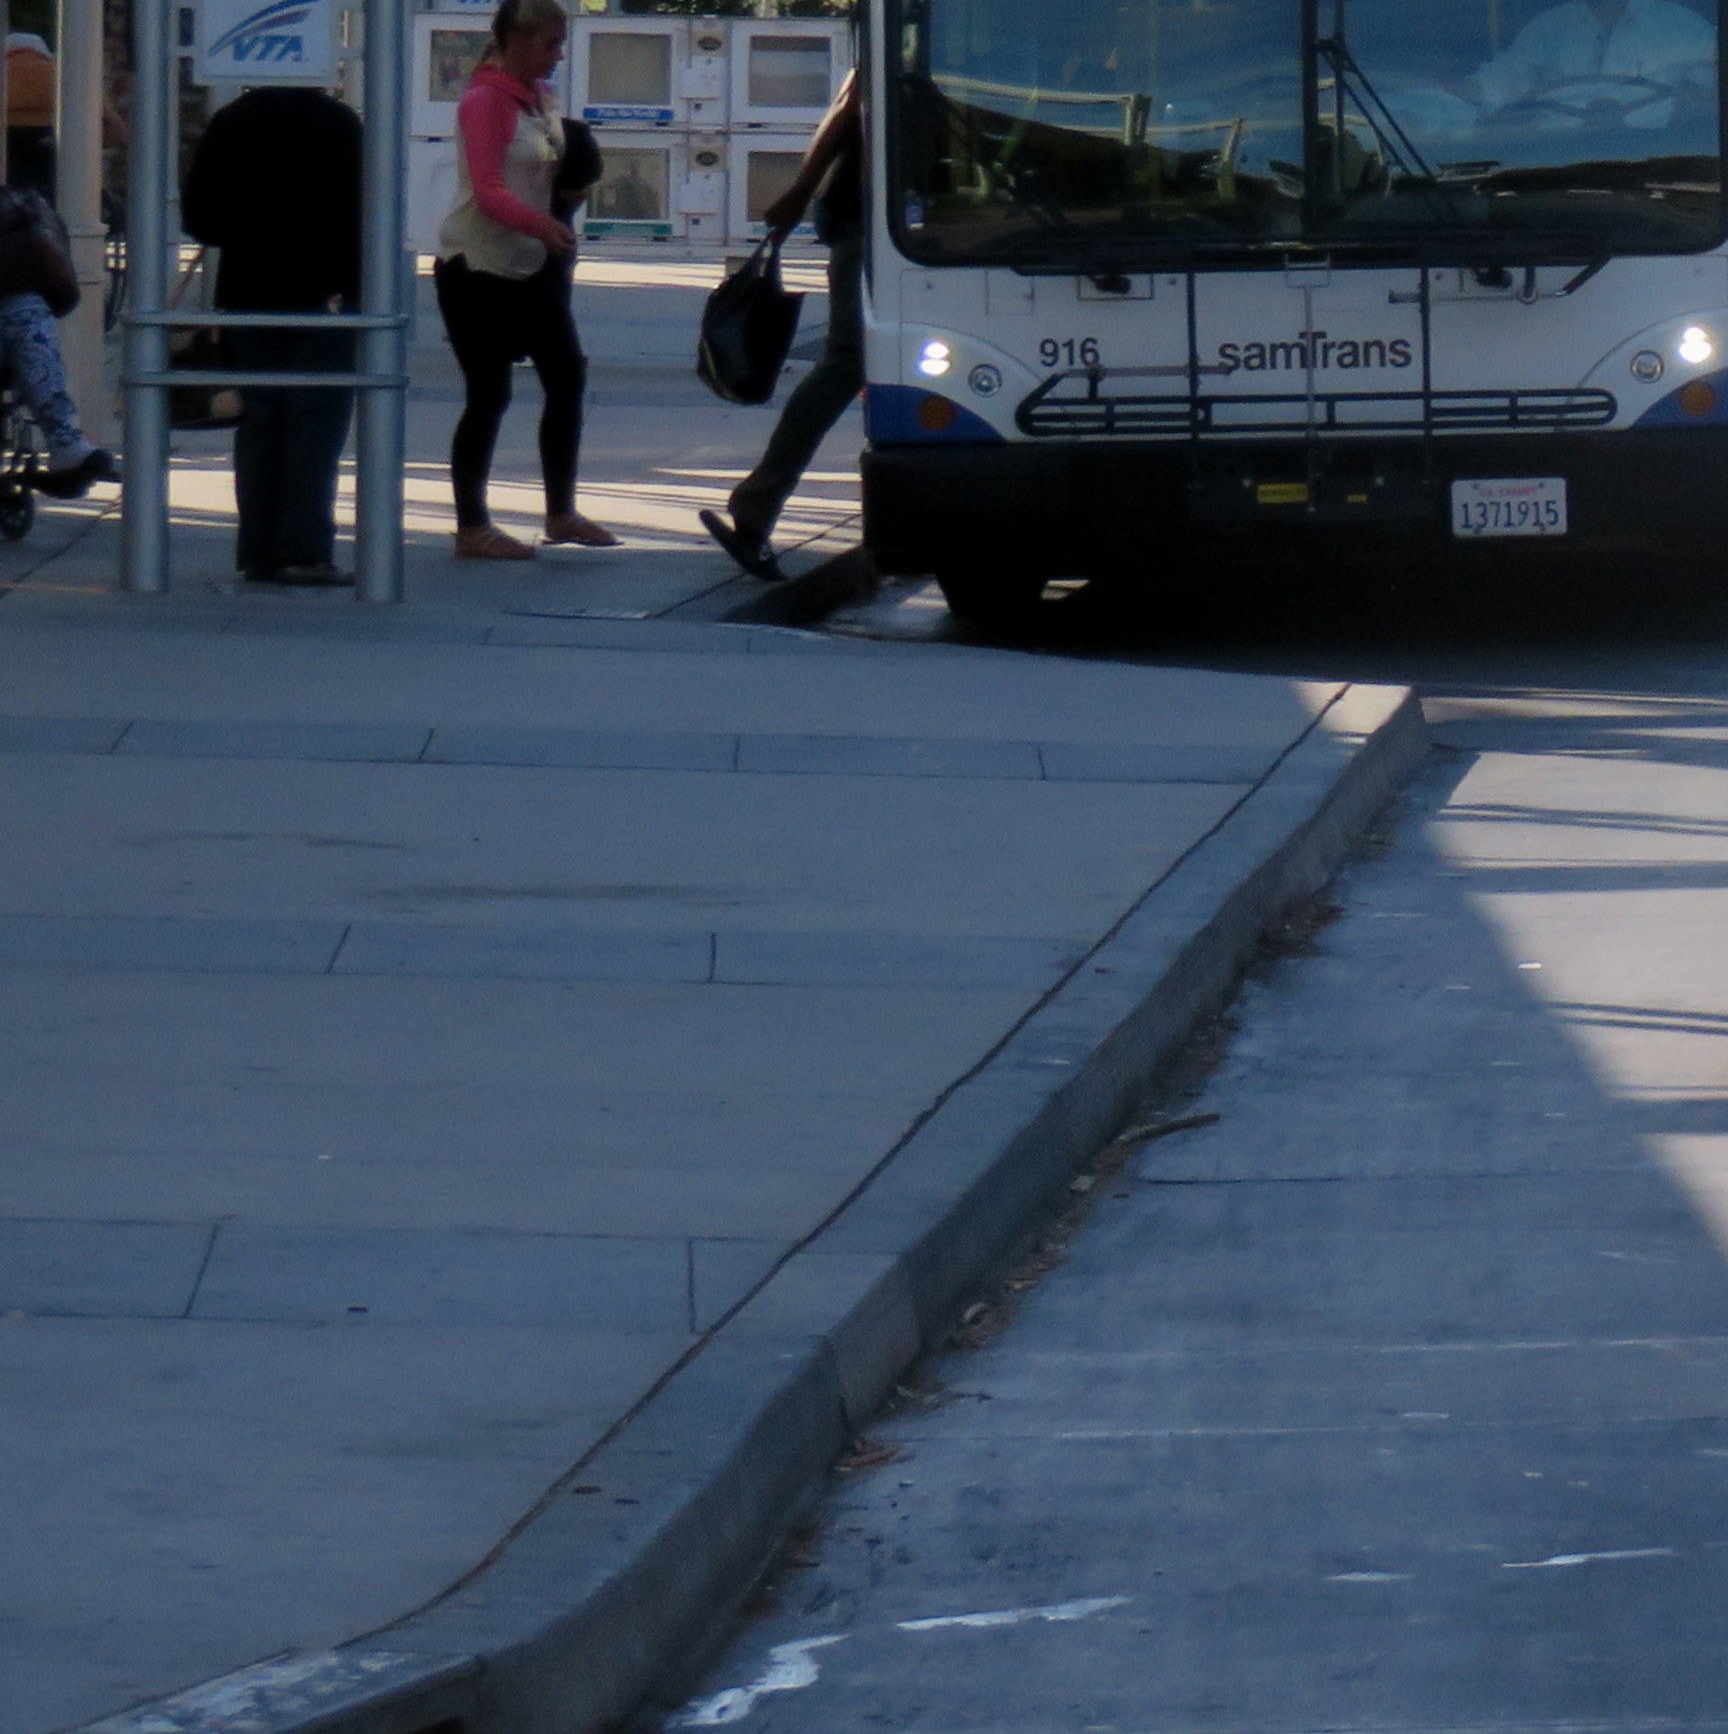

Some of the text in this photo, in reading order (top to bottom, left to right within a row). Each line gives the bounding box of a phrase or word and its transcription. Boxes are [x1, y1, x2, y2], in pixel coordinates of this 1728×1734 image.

[232, 34, 305, 62] VTA
[1038, 336, 1101, 367] 916
[1217, 330, 1413, 371] samTrans
[1460, 499, 1560, 530] 1371915
